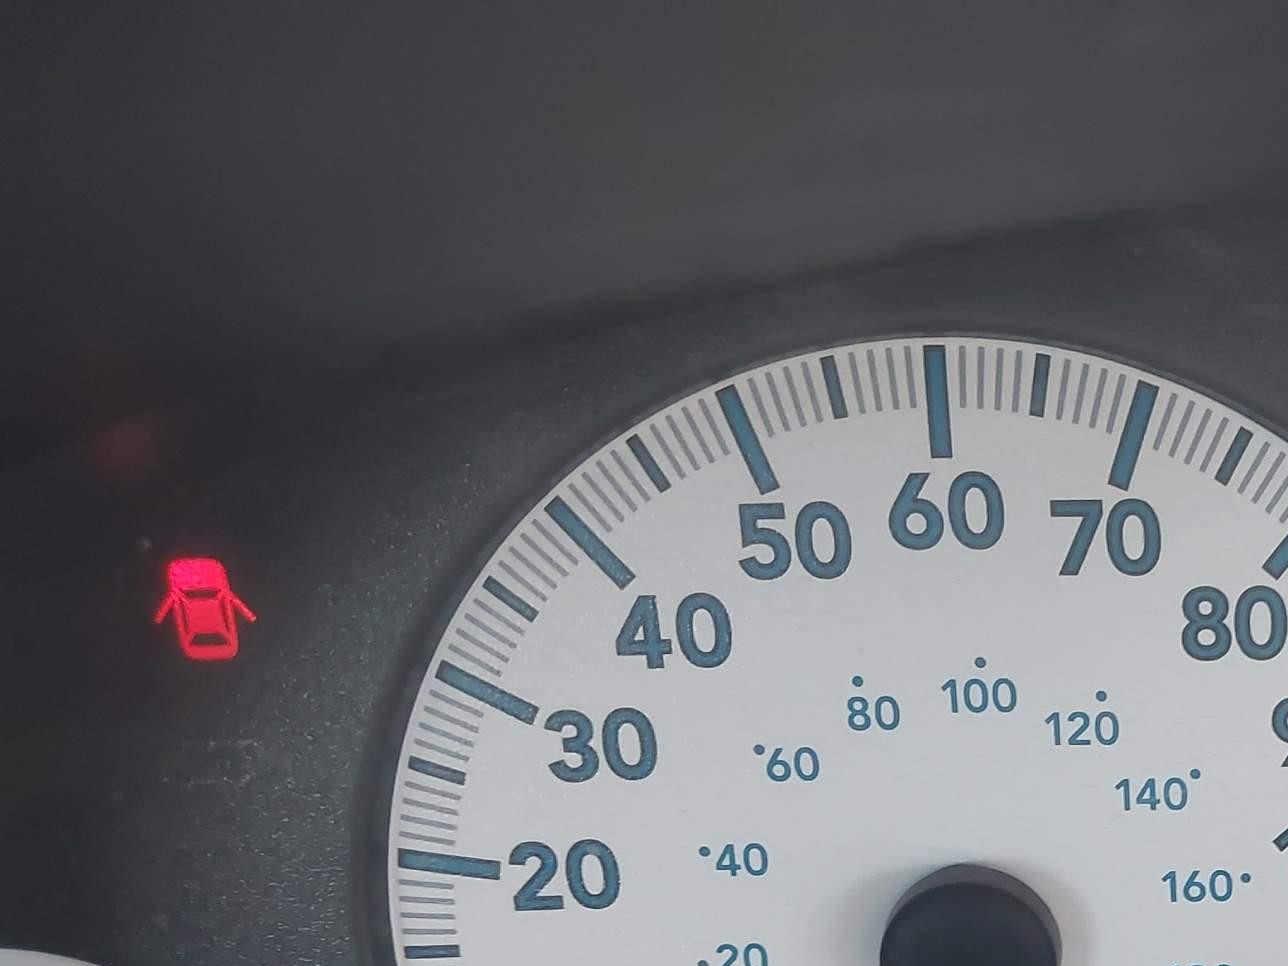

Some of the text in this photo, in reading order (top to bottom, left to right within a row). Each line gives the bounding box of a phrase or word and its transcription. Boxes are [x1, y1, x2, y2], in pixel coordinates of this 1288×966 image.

[889, 471, 1004, 550] 60
[1050, 498, 1161, 576] 70
[738, 501, 852, 580] 50
[616, 593, 732, 669] 40
[1182, 585, 1288, 661] 80
[847, 696, 900, 731] 80
[941, 678, 1017, 713] 100
[544, 708, 657, 783] 30
[1045, 711, 1119, 745] 120
[767, 747, 819, 782] 60
[1115, 778, 1187, 811] 140
[509, 839, 621, 911] 20
[716, 843, 768, 876] 40
[1162, 870, 1232, 902] 160
